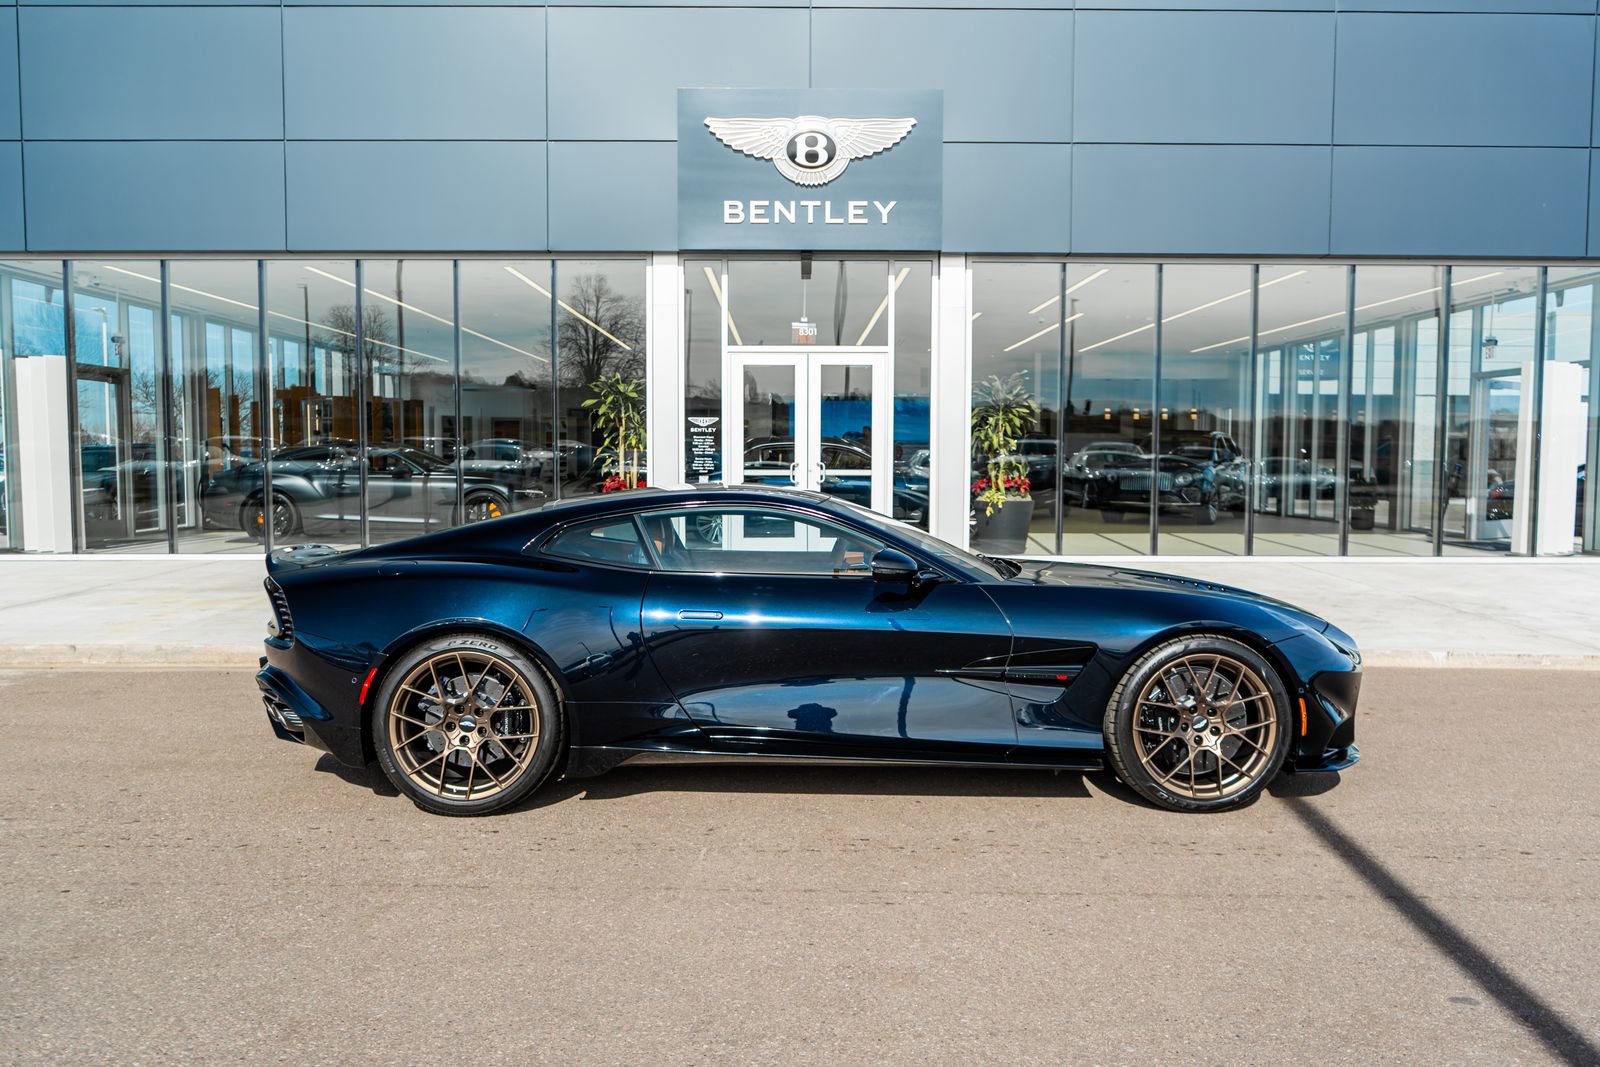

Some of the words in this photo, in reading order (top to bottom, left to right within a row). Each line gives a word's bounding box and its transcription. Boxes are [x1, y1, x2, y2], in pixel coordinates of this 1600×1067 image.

[795, 132, 828, 167] B
[723, 200, 897, 224] BENTLEY
[799, 328, 817, 336] 8301
[460, 641, 498, 650] ZERO
